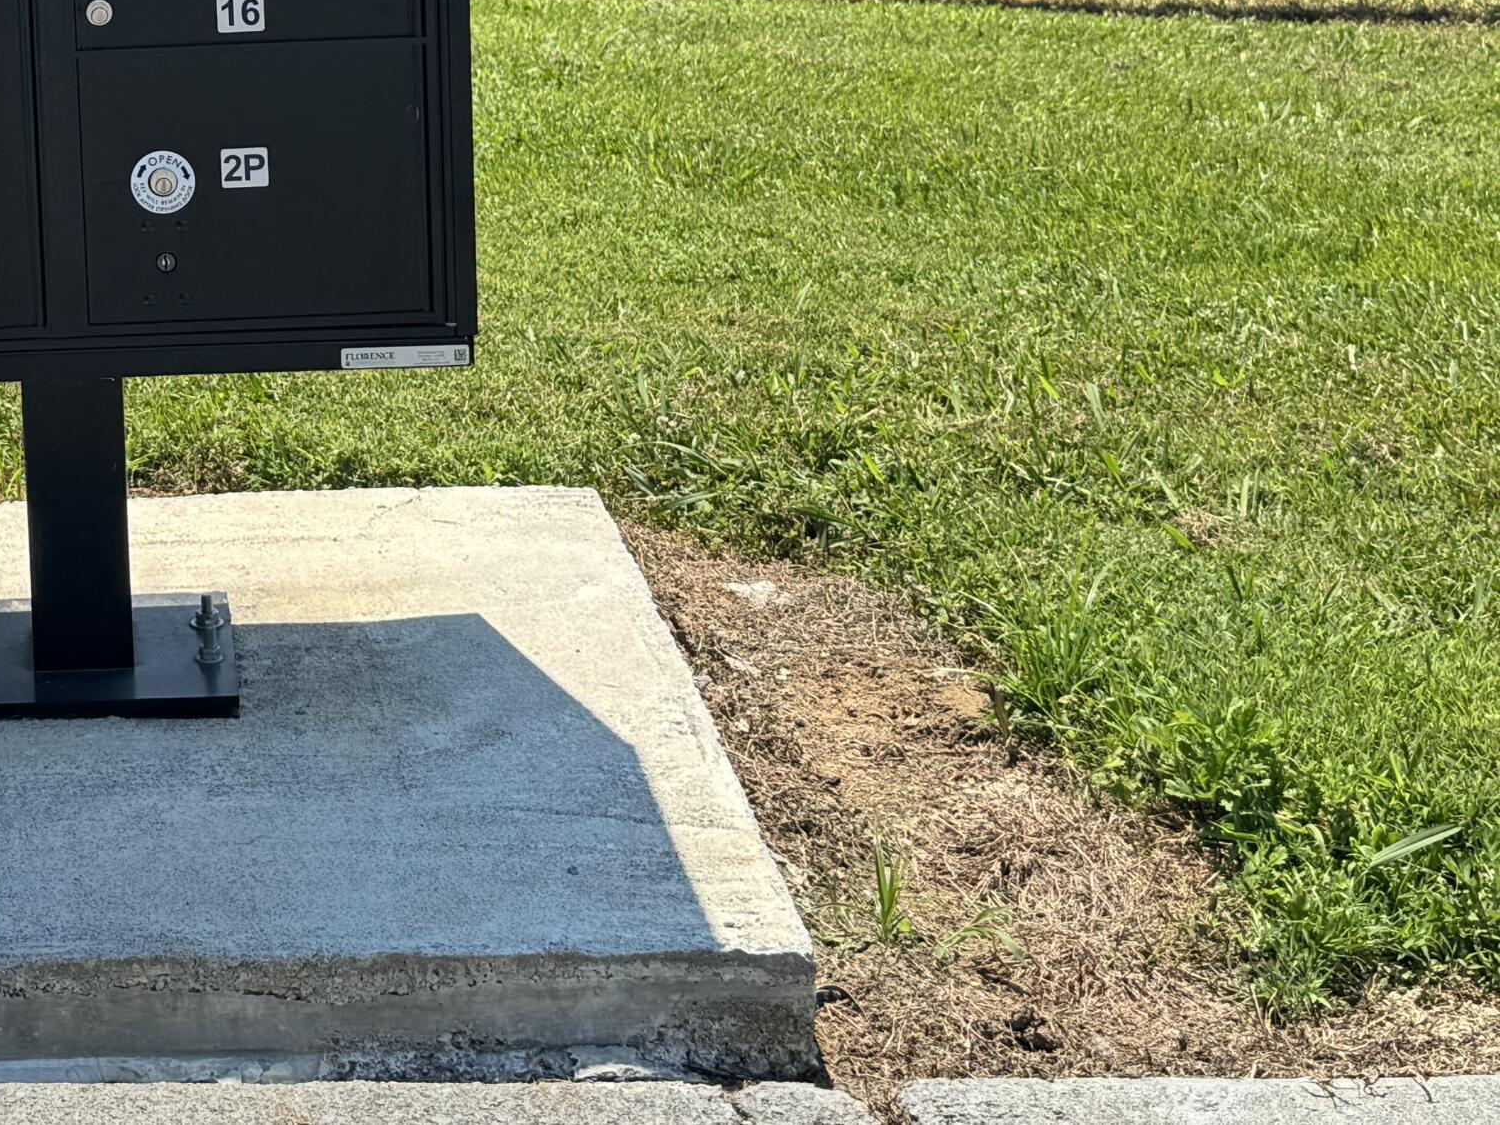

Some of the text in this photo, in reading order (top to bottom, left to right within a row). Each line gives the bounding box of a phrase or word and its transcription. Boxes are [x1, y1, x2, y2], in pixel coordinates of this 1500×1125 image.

[148, 155, 182, 168] OPEN
[224, 154, 265, 181] 2P
[345, 351, 395, 361] FLORENCE
